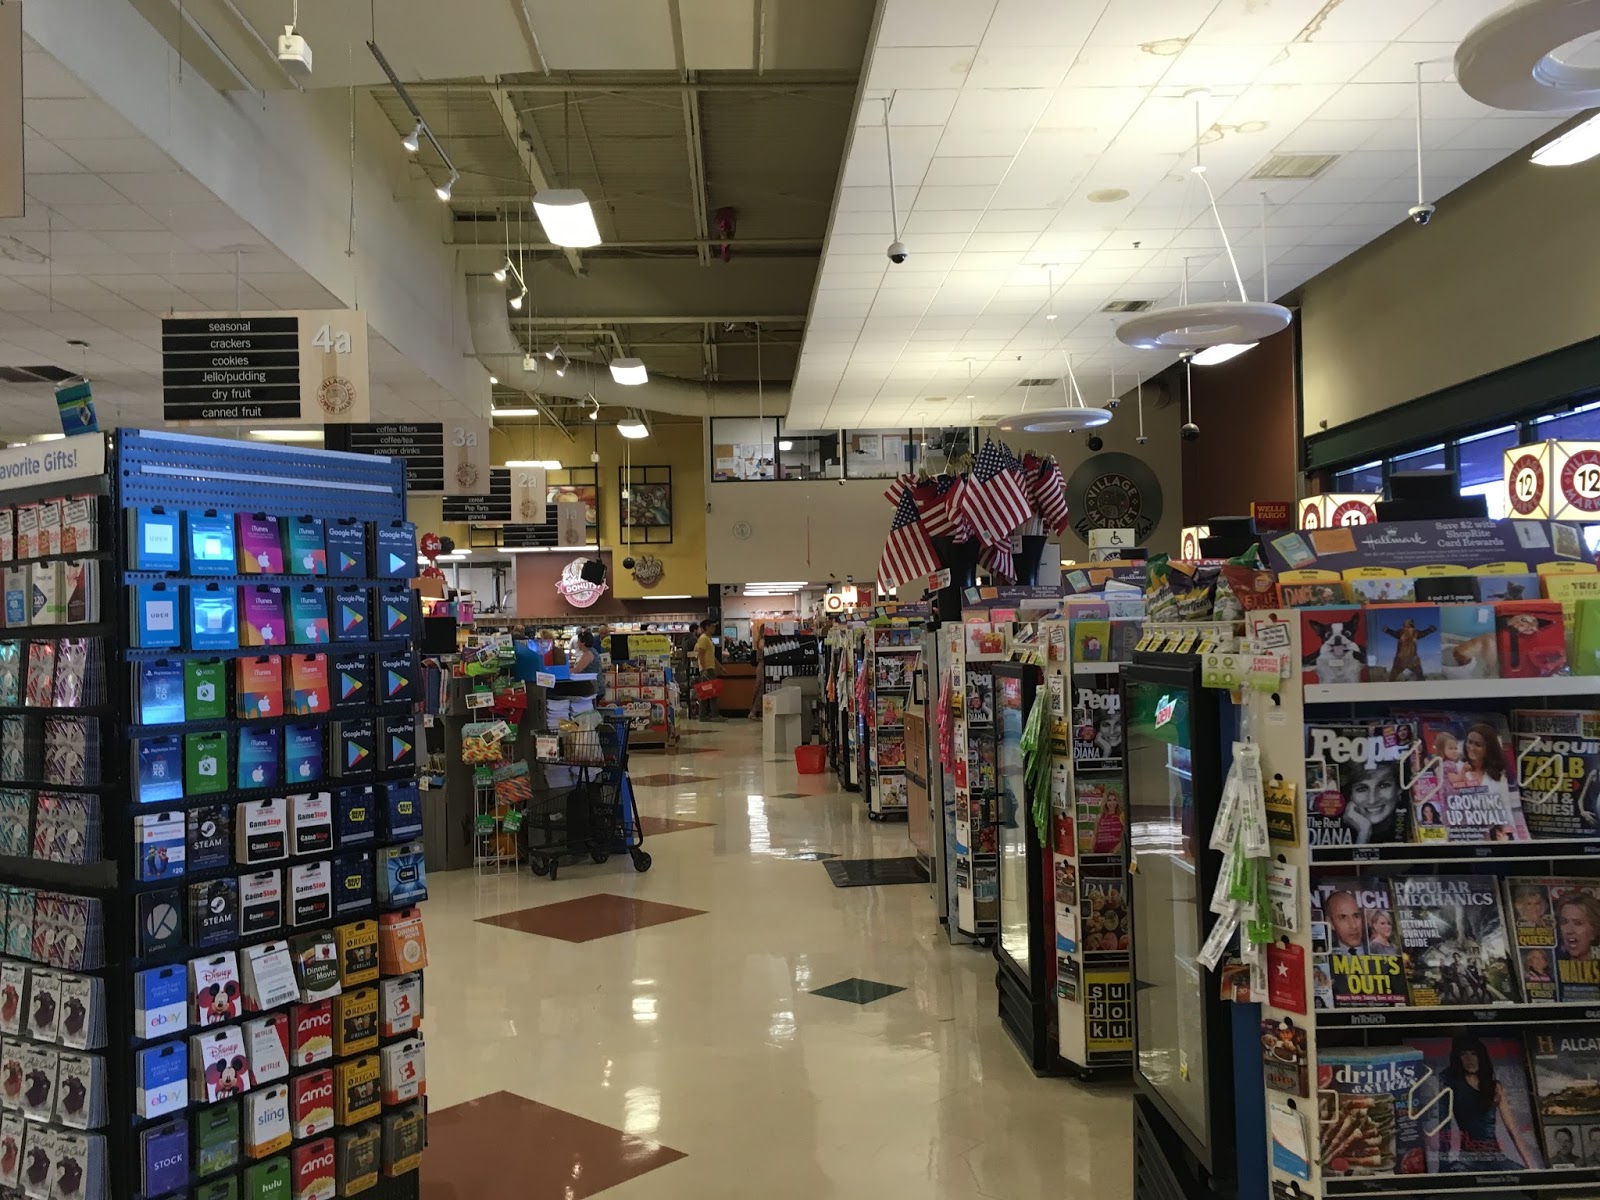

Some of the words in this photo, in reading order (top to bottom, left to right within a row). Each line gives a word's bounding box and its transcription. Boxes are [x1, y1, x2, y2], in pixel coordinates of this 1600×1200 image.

[208, 321, 251, 331] seasonal
[210, 338, 251, 349] crackers
[311, 324, 353, 354] 4a
[212, 356, 249, 367] cookies
[202, 371, 266, 384] Jello/pudding
[212, 389, 228, 401] dry
[231, 388, 251, 399] fruit
[202, 406, 238, 418] canned
[241, 405, 262, 417] fruit
[376, 425, 398, 434] coffee
[452, 427, 479, 447] 3a
[374, 446, 398, 456] powder
[399, 446, 420, 455] drinks
[0, 456, 40, 480] avorite
[43, 448, 77, 472] Gifts!
[1564, 453, 1600, 476] VILLA
[517, 472, 538, 488] 2a
[1519, 474, 1533, 496] 12
[1579, 469, 1600, 491] 12
[1087, 476, 1137, 498] VILLAGE
[1565, 489, 1600, 510] MARK
[1257, 504, 1286, 513] WELLS
[1334, 503, 1374, 521] VILLAGE
[1089, 507, 1138, 528] MARKET
[1257, 511, 1286, 520] FARGO
[251, 524, 269, 534] iTunes
[1435, 520, 1459, 531] Save
[1460, 520, 1473, 531] $2
[1475, 519, 1497, 530] with
[298, 527, 315, 536] iTunes
[329, 527, 348, 538] Google
[349, 529, 364, 540] Play
[379, 530, 399, 540] Google
[399, 532, 413, 542] Play
[1445, 529, 1491, 540] ShopRite
[1361, 531, 1429, 549] Hallmark
[1437, 537, 1460, 548] Card
[1461, 536, 1504, 547] Rewards
[336, 595, 354, 605] Google
[354, 595, 366, 604] Play
[382, 595, 399, 604] Google
[399, 595, 410, 604] Play
[335, 661, 353, 671] Google
[353, 661, 365, 671] Play
[382, 659, 399, 669] Google
[399, 659, 411, 669] Play
[254, 668, 272, 677] iTunes
[301, 666, 318, 675] iTunes
[1077, 688, 1121, 714] Peop
[342, 729, 360, 740] Google
[360, 729, 372, 739] Play
[386, 725, 403, 735] Google
[403, 724, 415, 735] Play
[250, 738, 268, 747] iTunes
[295, 734, 312, 742] iTunes
[1074, 746, 1100, 759] DIANA
[1446, 793, 1503, 810] GROWING
[1561, 792, 1574, 804] &
[297, 810, 327, 821] GameStop
[1524, 803, 1574, 816] BONES!
[1308, 817, 1323, 828] The
[1323, 817, 1342, 828] Real
[1446, 810, 1463, 825] UP
[1464, 808, 1509, 825] ROYAL!
[249, 818, 282, 829] GameStop
[300, 832, 328, 842] GameStop
[1306, 827, 1353, 846] DIANA
[193, 838, 222, 850] STEAM
[251, 840, 281, 851] GameStop
[295, 881, 326, 894] GameStop
[1394, 881, 1471, 895] POPULAR
[245, 889, 277, 900] GameStop
[1397, 891, 1494, 907] MECHANICS
[297, 902, 326, 914] GameStop
[203, 914, 232, 926] STEAM
[1399, 910, 1414, 919] THE
[1401, 920, 1438, 929] ULTIMATE
[354, 934, 376, 945] REGAL
[1403, 929, 1441, 939] SURVIVAL
[1404, 938, 1429, 948] GUIDE
[306, 964, 325, 976] Dinner
[1332, 955, 1401, 975] MATT'S
[317, 969, 337, 980] Movie
[1347, 974, 1392, 995] OUT!
[350, 1004, 375, 1016] REGAL
[298, 1013, 331, 1031] amc
[1350, 1014, 1387, 1025] InTouch
[254, 1029, 273, 1039] NETFLIX
[260, 1062, 281, 1073] NETFLIX
[1335, 1061, 1416, 1085] drinks
[354, 1072, 377, 1084] REGAL
[300, 1084, 333, 1104] amc
[258, 1107, 285, 1126] sling
[154, 1154, 183, 1171] STOCK
[301, 1154, 334, 1176] amc
[262, 1180, 282, 1194] hulu
